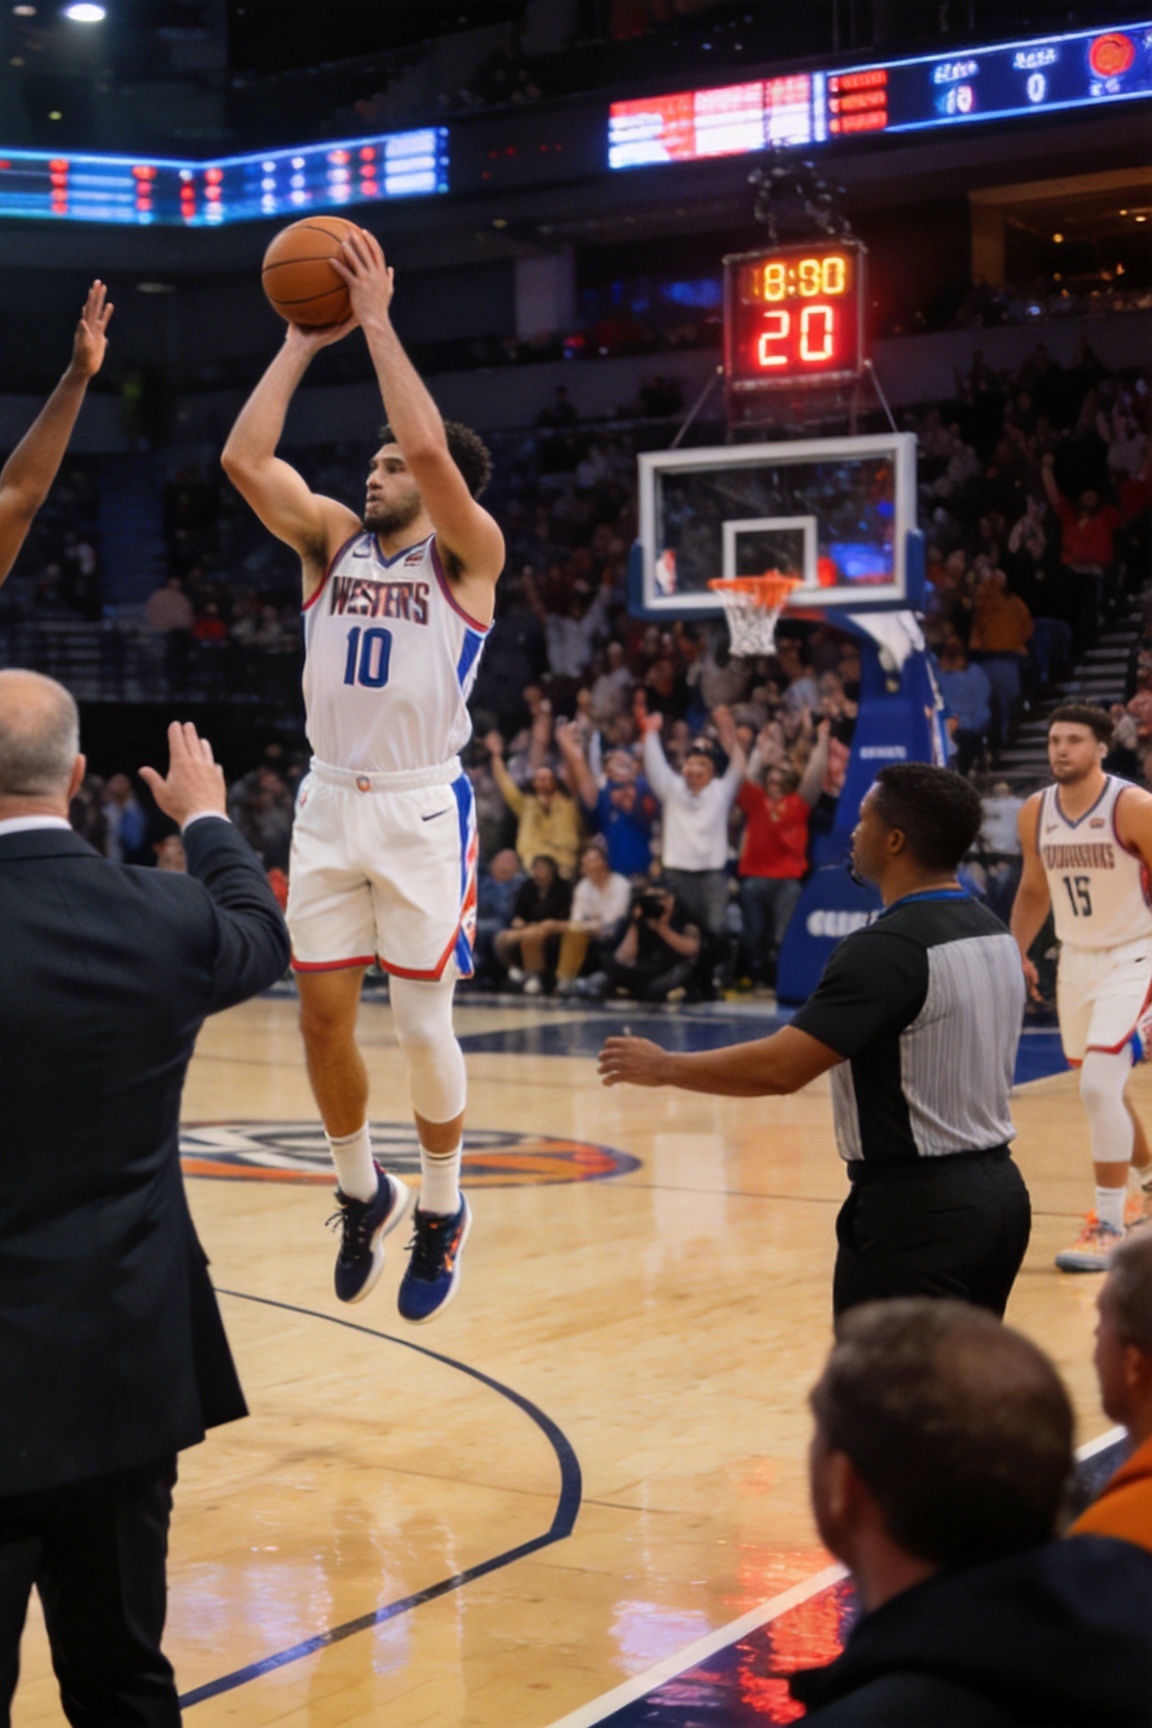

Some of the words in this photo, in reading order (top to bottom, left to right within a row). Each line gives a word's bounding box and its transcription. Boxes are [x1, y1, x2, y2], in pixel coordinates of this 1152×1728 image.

[758, 305, 833, 366] 20
[344, 626, 392, 688] 10
[1063, 876, 1092, 917] 15
